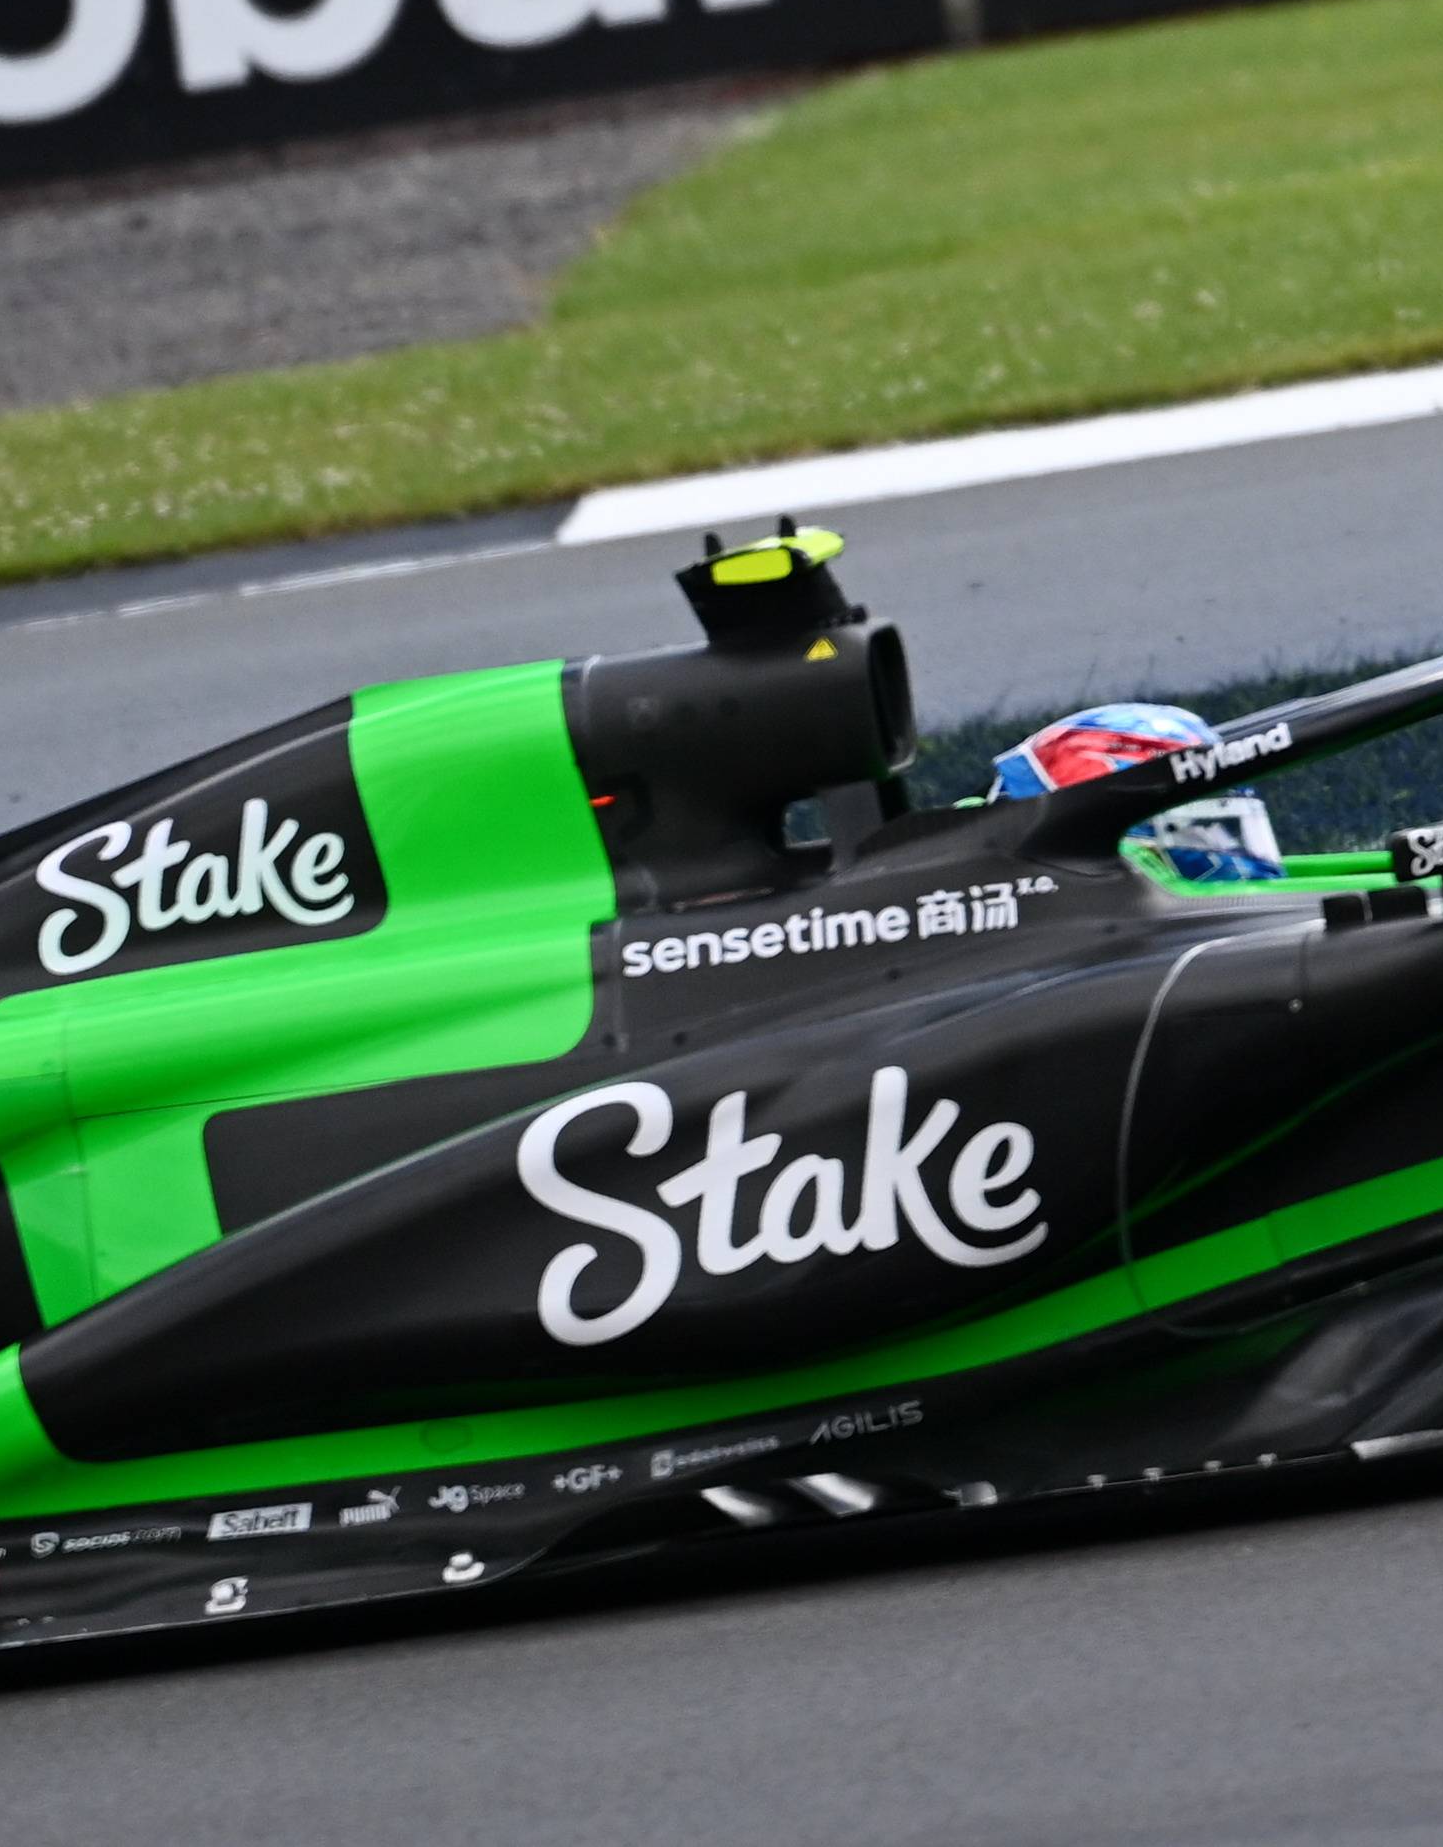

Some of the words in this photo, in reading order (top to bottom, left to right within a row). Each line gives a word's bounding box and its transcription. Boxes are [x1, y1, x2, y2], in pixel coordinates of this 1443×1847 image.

[1172, 721, 1294, 784] Hyland
[36, 798, 354, 976] Stake
[623, 886, 911, 978] sensetime
[916, 883, 1019, 940] 商汤
[517, 1065, 1049, 1346] Stake
[809, 1399, 924, 1445] AGILIS
